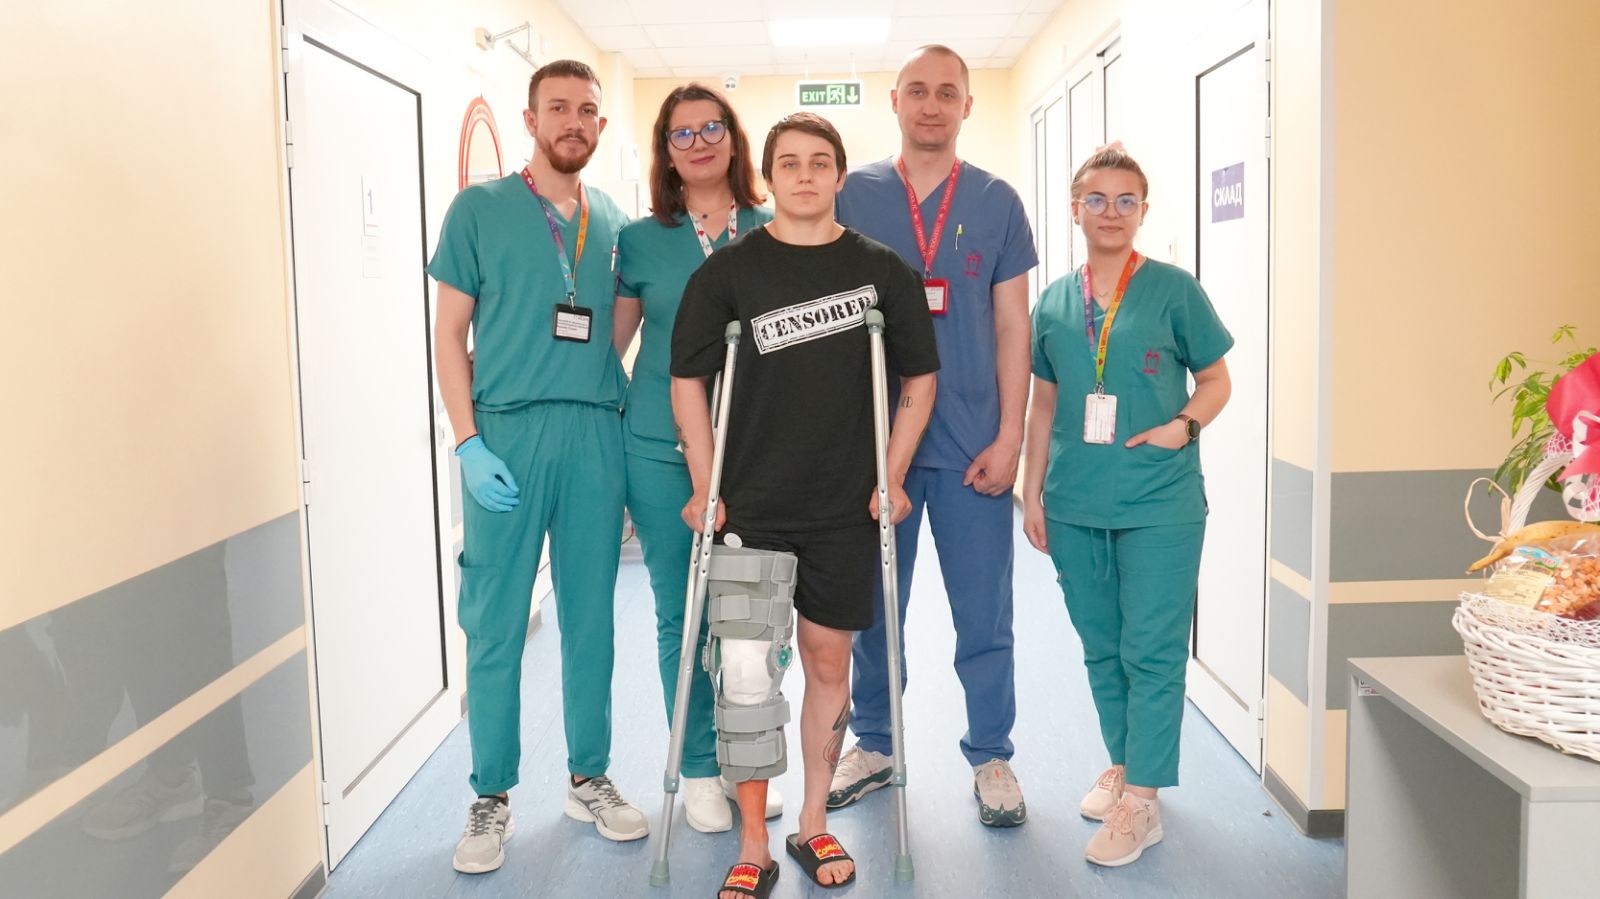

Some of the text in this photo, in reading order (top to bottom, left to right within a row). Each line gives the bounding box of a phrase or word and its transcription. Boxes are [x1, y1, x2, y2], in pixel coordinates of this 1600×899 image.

[802, 90, 826, 103] EXIT
[367, 187, 373, 215] 1
[1214, 182, 1242, 208] СКЛАД
[761, 296, 871, 341] CENSORED
